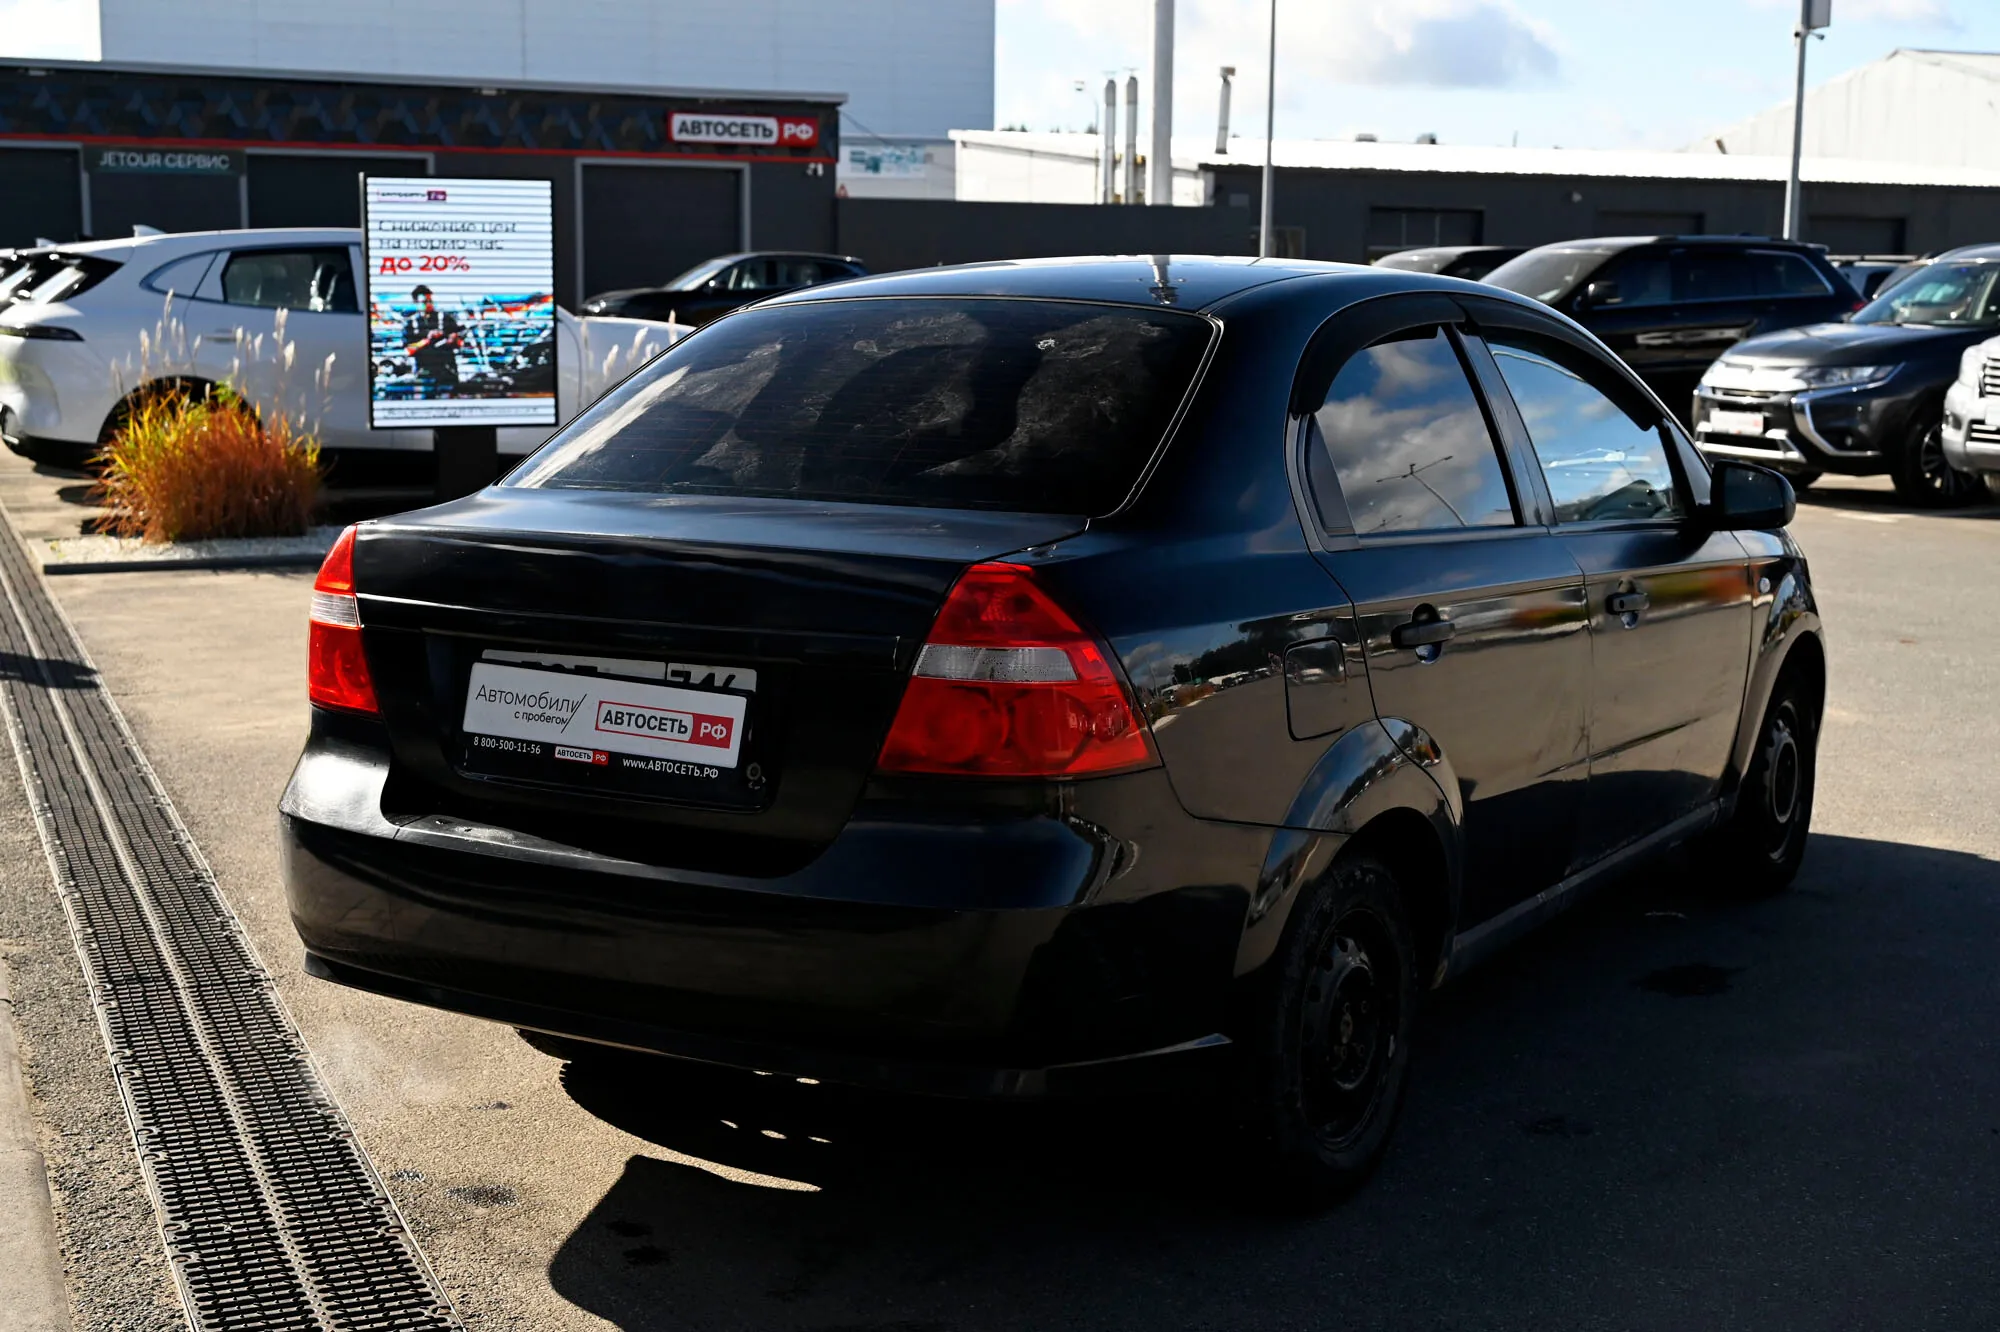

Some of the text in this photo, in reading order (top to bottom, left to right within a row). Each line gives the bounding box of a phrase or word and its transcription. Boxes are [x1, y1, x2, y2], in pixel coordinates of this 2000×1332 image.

[677, 119, 814, 140] АВТОСЕТЬ РФ
[100, 151, 230, 170] JETOUR СЕРВИС
[380, 255, 471, 275] до 20%
[475, 683, 580, 713] Автомобили
[514, 710, 569, 726] с пробегом
[602, 709, 728, 740] АВТОСЕТЬ РФ
[473, 736, 541, 755] 8 800-500-11-56
[556, 747, 607, 762] АВТОСЕТЬ РФ
[622, 758, 719, 779] www.АВТОСЕТЬ.РФ
